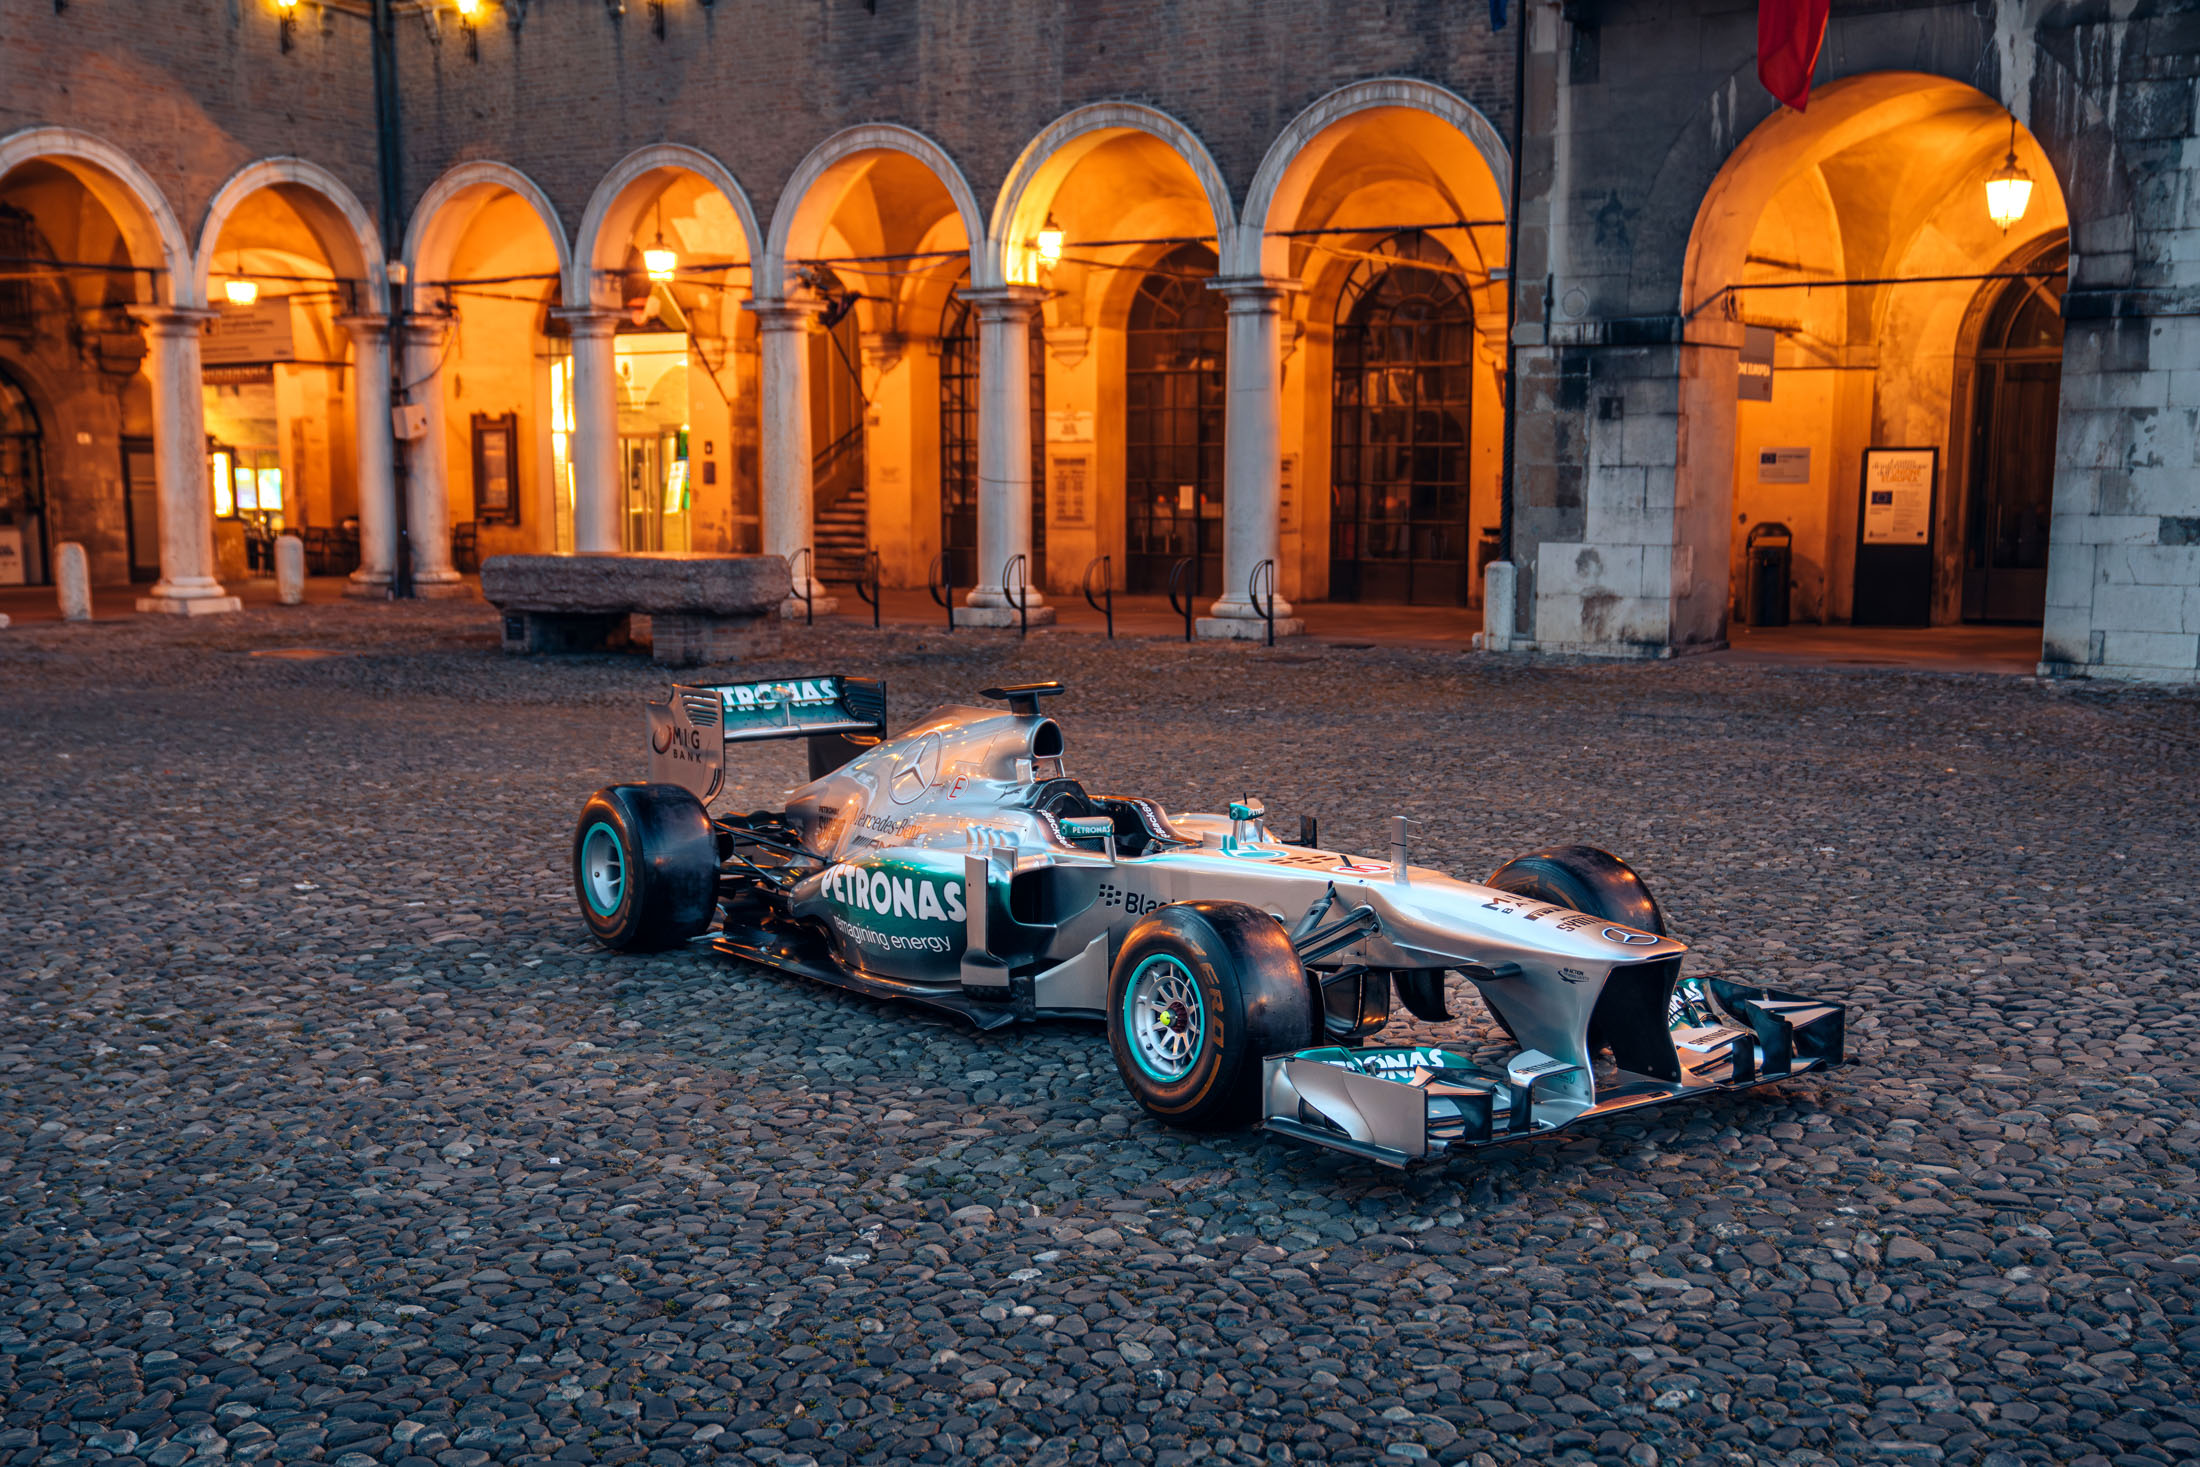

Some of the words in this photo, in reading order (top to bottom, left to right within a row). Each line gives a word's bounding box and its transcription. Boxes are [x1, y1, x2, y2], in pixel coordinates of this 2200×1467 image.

[721, 679, 838, 712] TRONAS
[673, 728, 700, 749] MIG
[673, 750, 701, 764] BANK
[851, 807, 923, 841] Mercedes-Benz
[1072, 826, 1111, 834] PETRONAS
[820, 864, 967, 923] PETRONAS
[892, 932, 952, 953] energy
